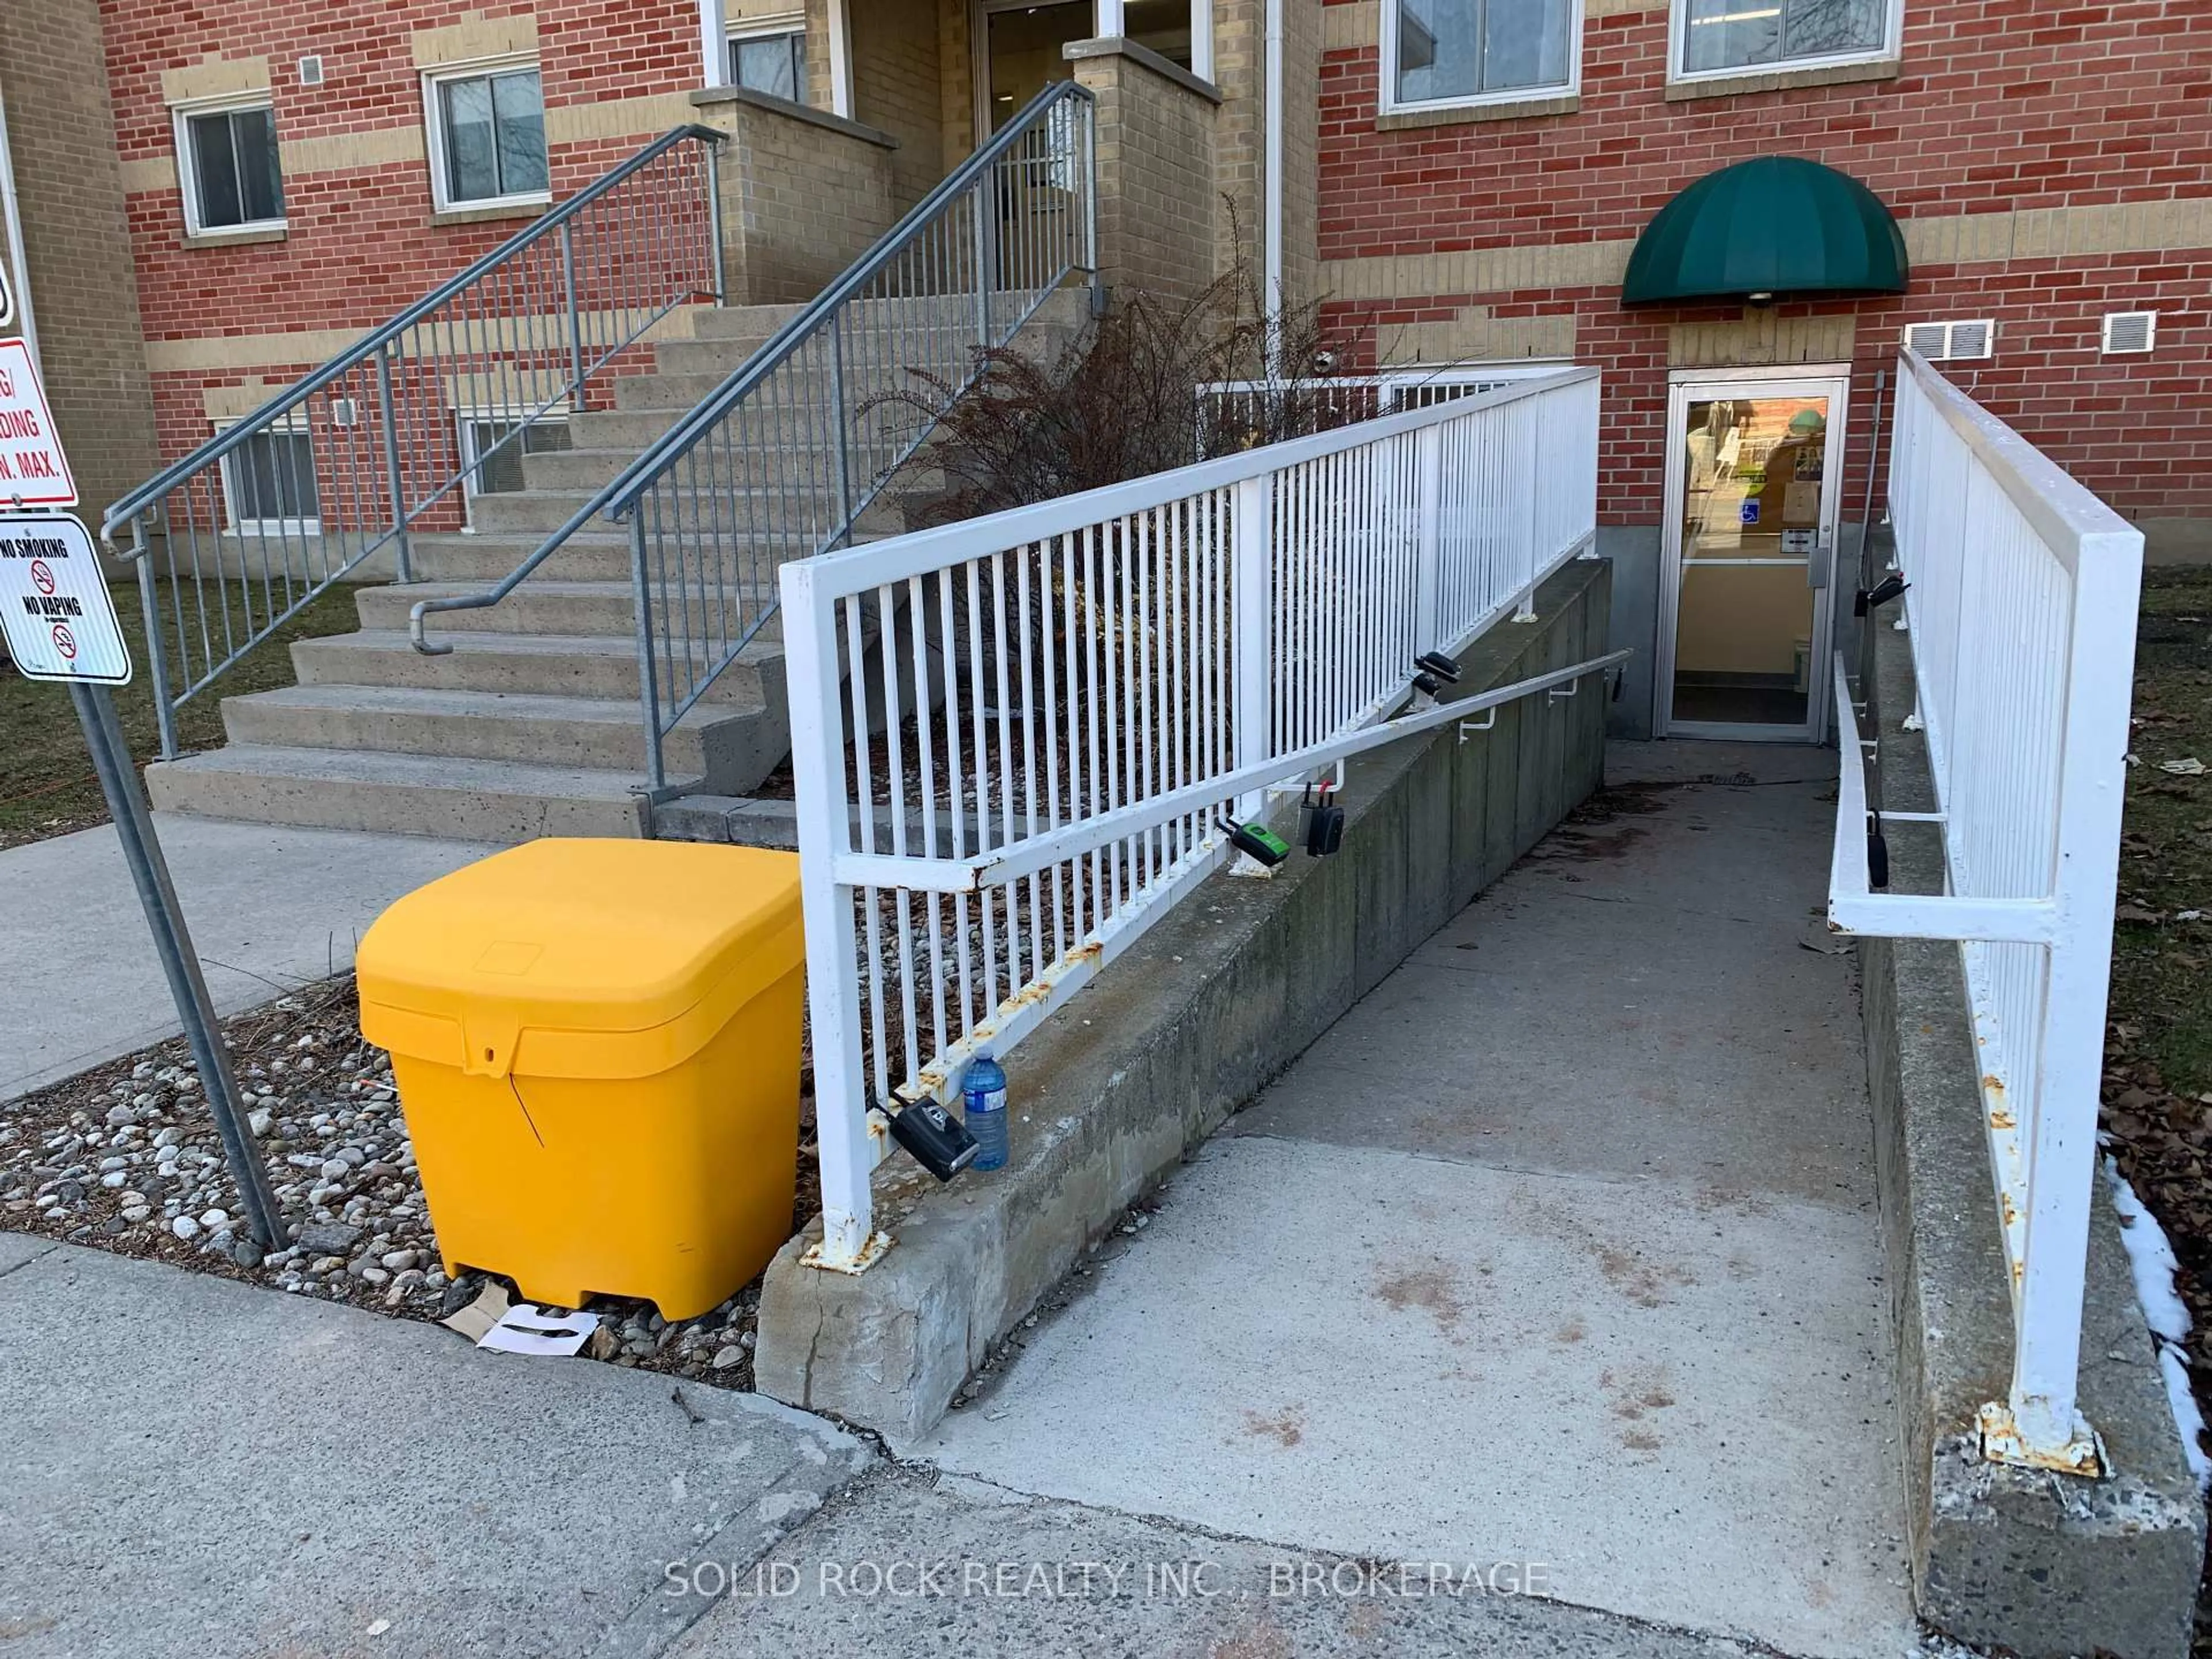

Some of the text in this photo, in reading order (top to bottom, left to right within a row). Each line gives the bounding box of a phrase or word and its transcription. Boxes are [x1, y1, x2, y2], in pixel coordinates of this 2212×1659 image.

[0, 410, 40, 438] DING
[16, 450, 60, 479] MAX.
[0, 539, 69, 558] NO SMOKING
[22, 596, 82, 616] NO VAPING
